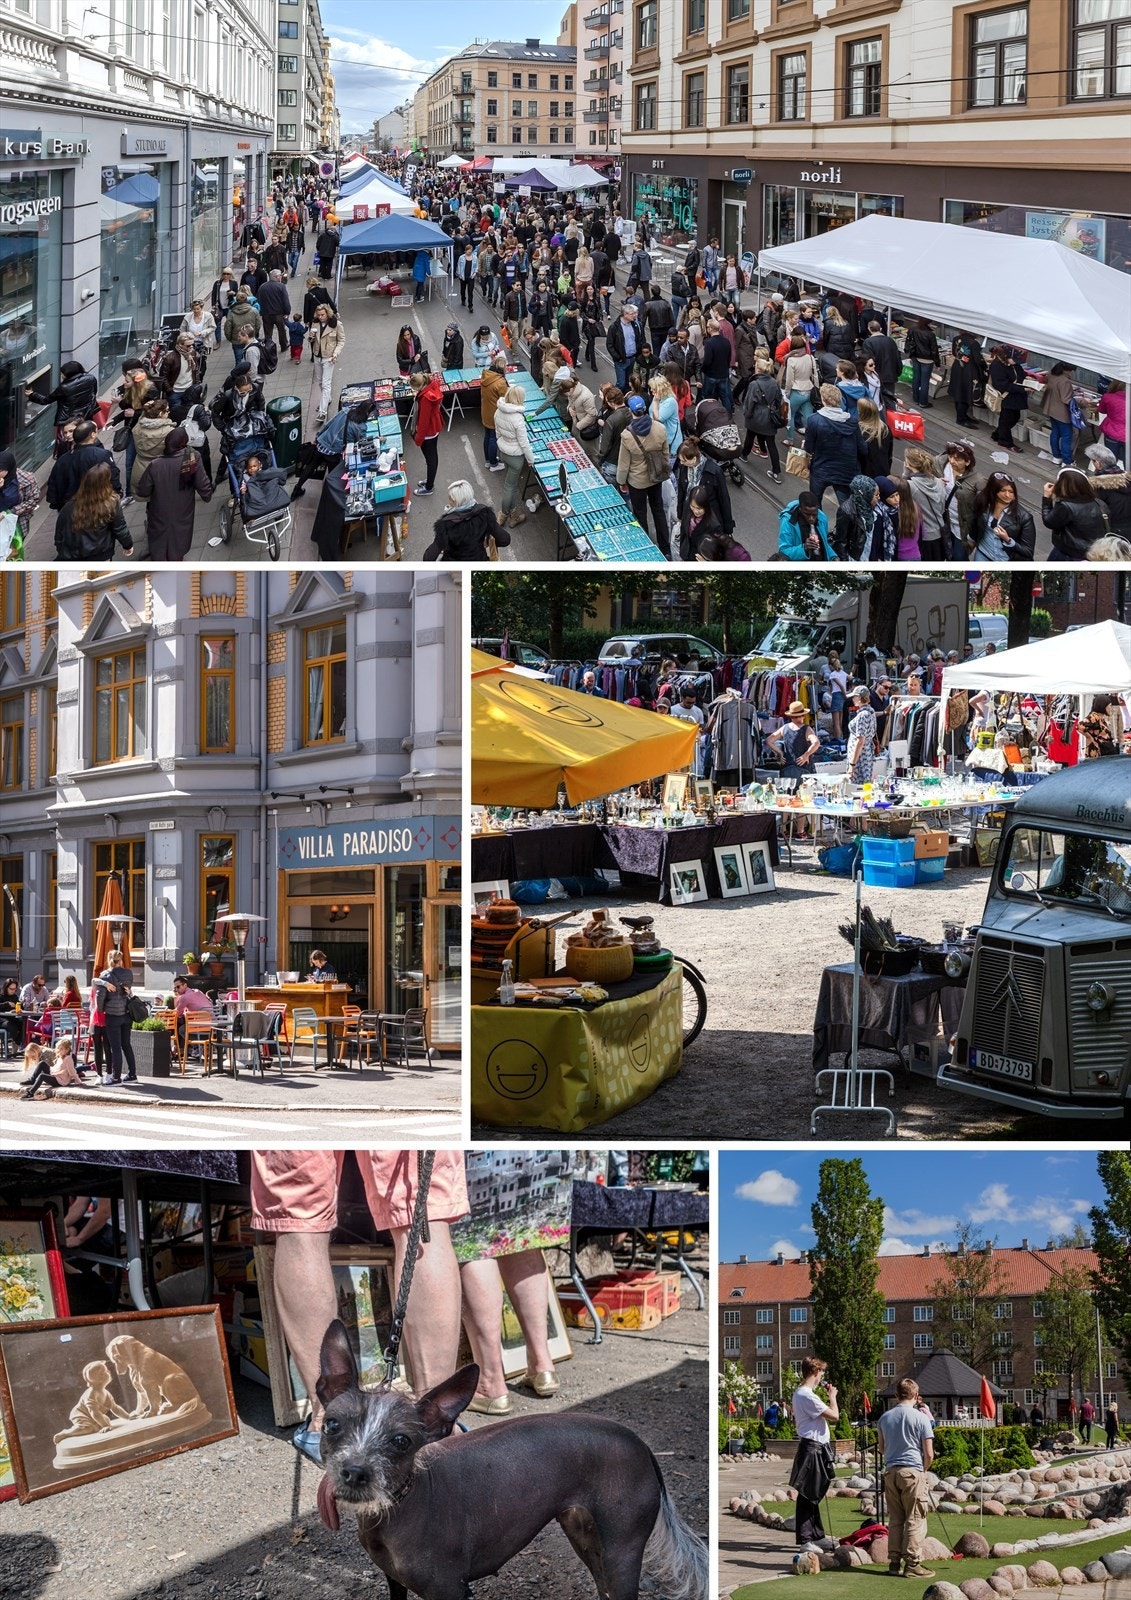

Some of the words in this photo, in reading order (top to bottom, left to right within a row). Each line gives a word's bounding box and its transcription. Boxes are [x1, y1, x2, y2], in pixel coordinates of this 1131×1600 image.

[5, 137, 42, 155] kus
[53, 138, 93, 154] Bank
[135, 139, 157, 152] STUDIO
[734, 170, 750, 179] norli
[800, 167, 842, 184] norli
[0, 195, 62, 225] rogsveen
[673, 201, 692, 230] 40
[1031, 217, 1063, 227] Reise-
[1031, 225, 1067, 236] lysten?
[894, 419, 914, 432] HH
[1075, 804, 1125, 824] Bacchus
[298, 834, 334, 860] VILLA
[343, 828, 413, 856] PARADISO
[980, 1053, 994, 1068] BD
[999, 1058, 1031, 1078] 73793
